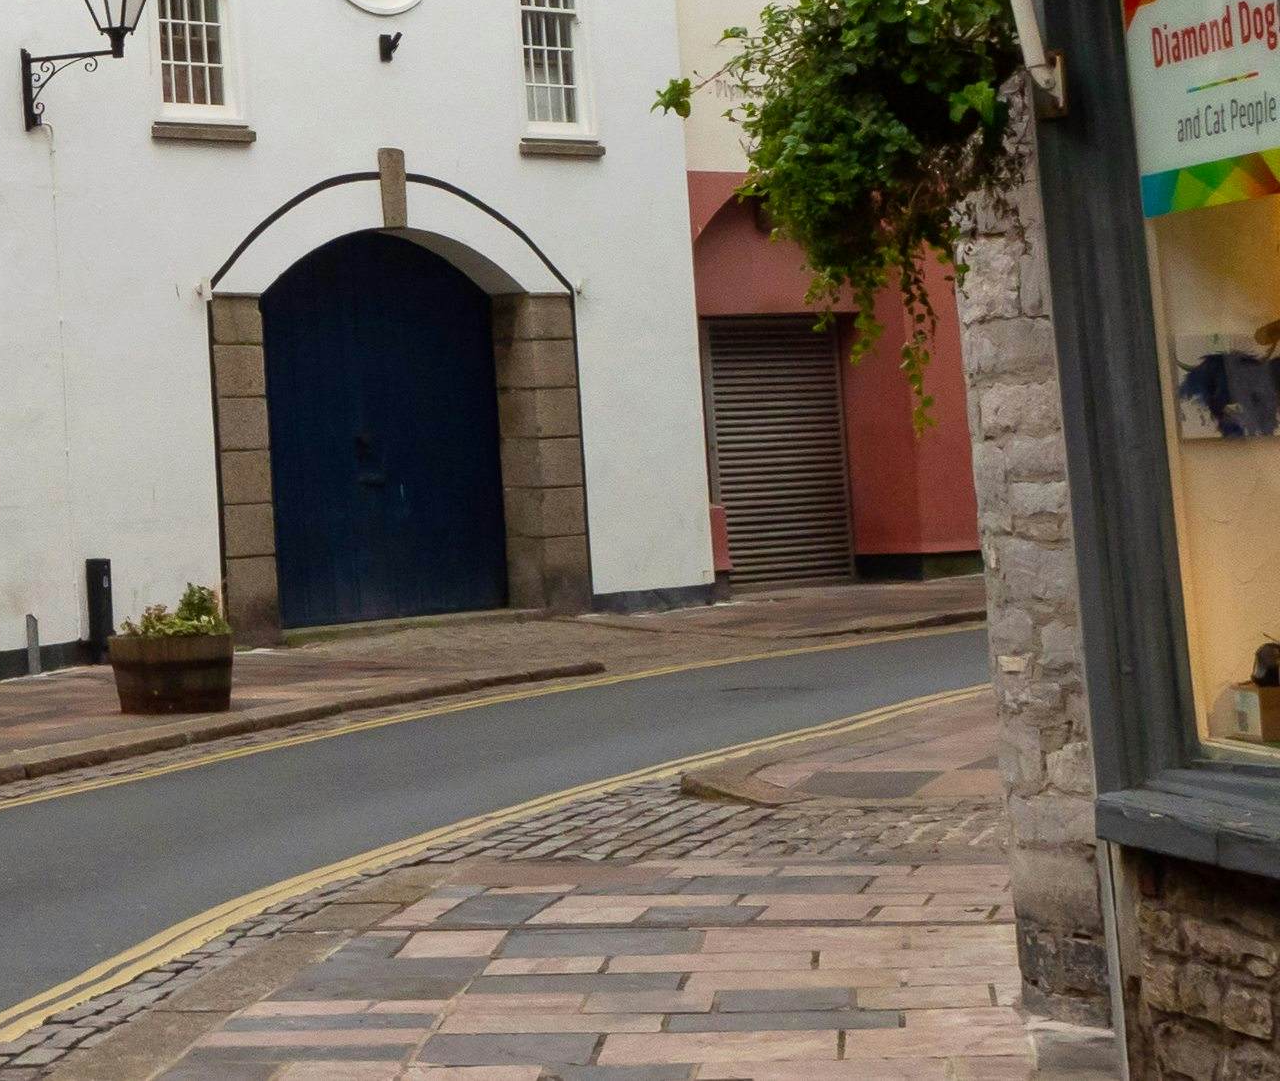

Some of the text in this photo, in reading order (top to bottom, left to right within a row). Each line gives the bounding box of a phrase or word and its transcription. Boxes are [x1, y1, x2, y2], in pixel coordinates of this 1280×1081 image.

[1151, 0, 1280, 69] Diamond Dog
[1176, 89, 1278, 143] and Cat People
